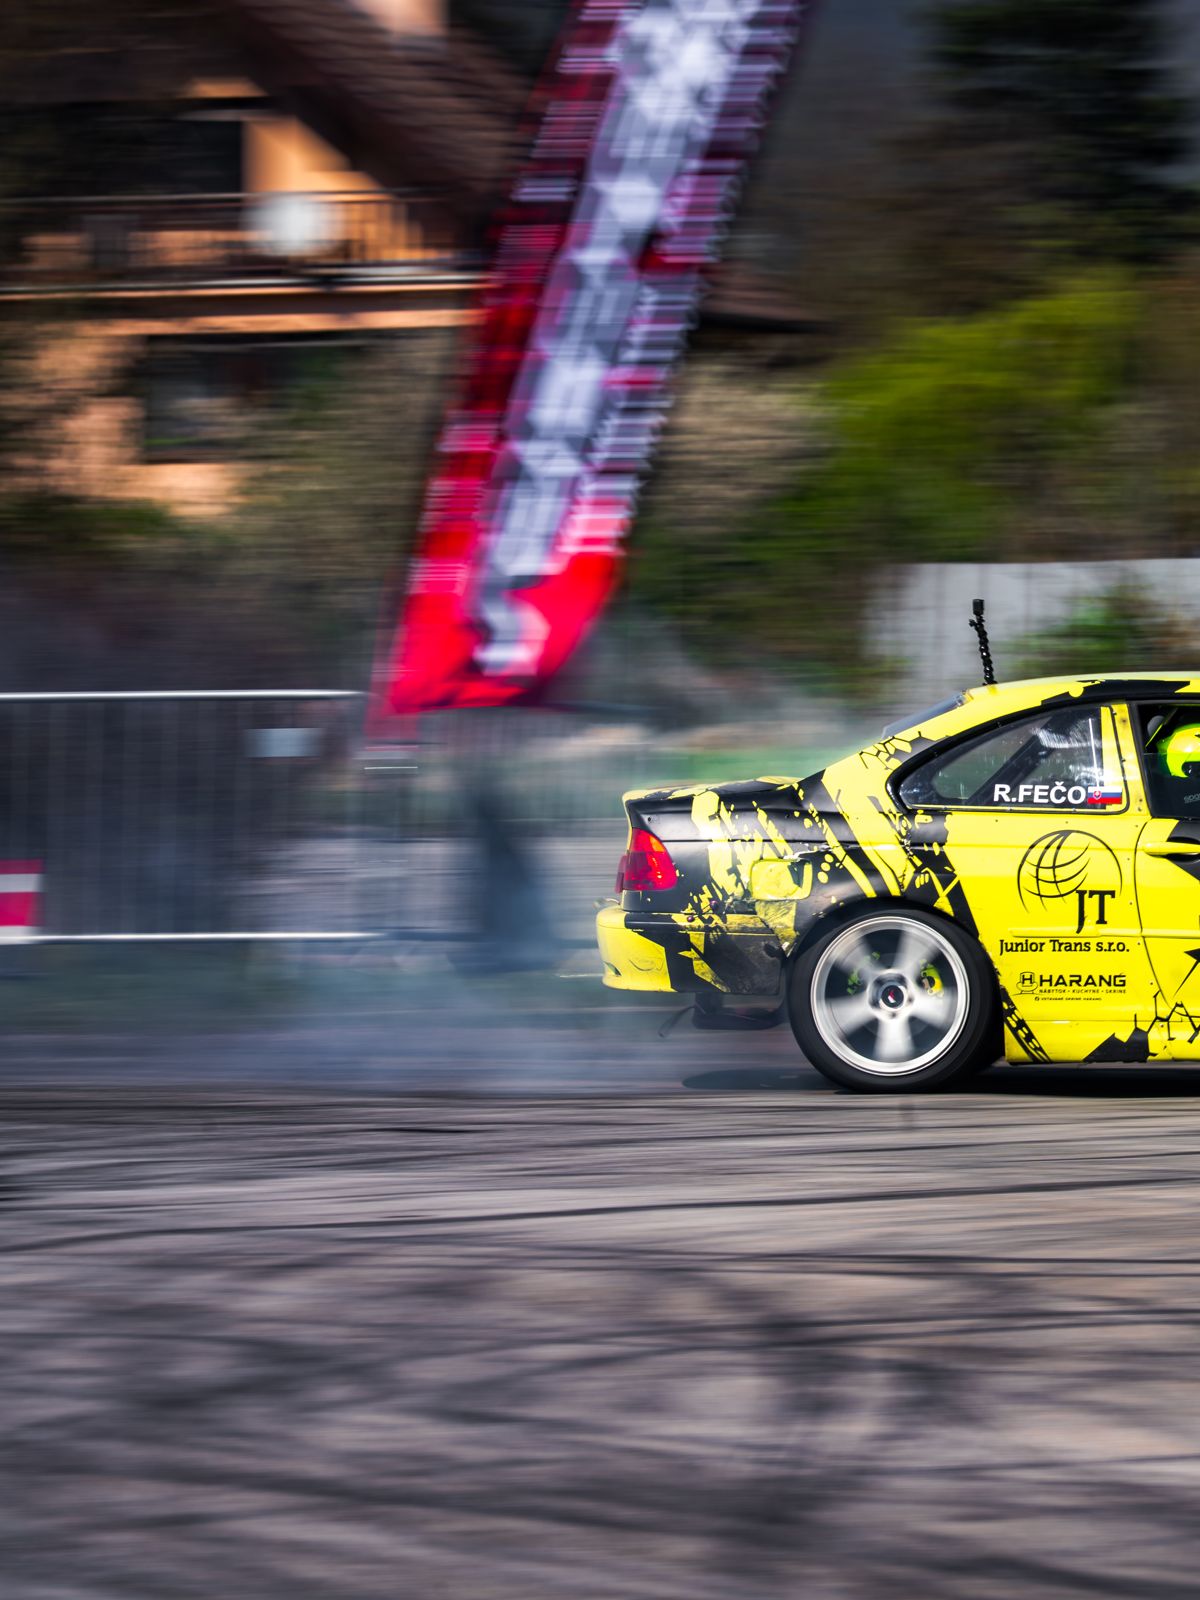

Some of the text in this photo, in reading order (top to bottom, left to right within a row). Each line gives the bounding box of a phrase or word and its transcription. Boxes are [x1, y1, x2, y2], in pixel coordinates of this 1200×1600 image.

[993, 781, 1086, 804] R.FEČO
[1075, 889, 1116, 934] JT
[1000, 939, 1130, 956] Junior Trans s.r.o.
[1040, 974, 1127, 987] HARANG
